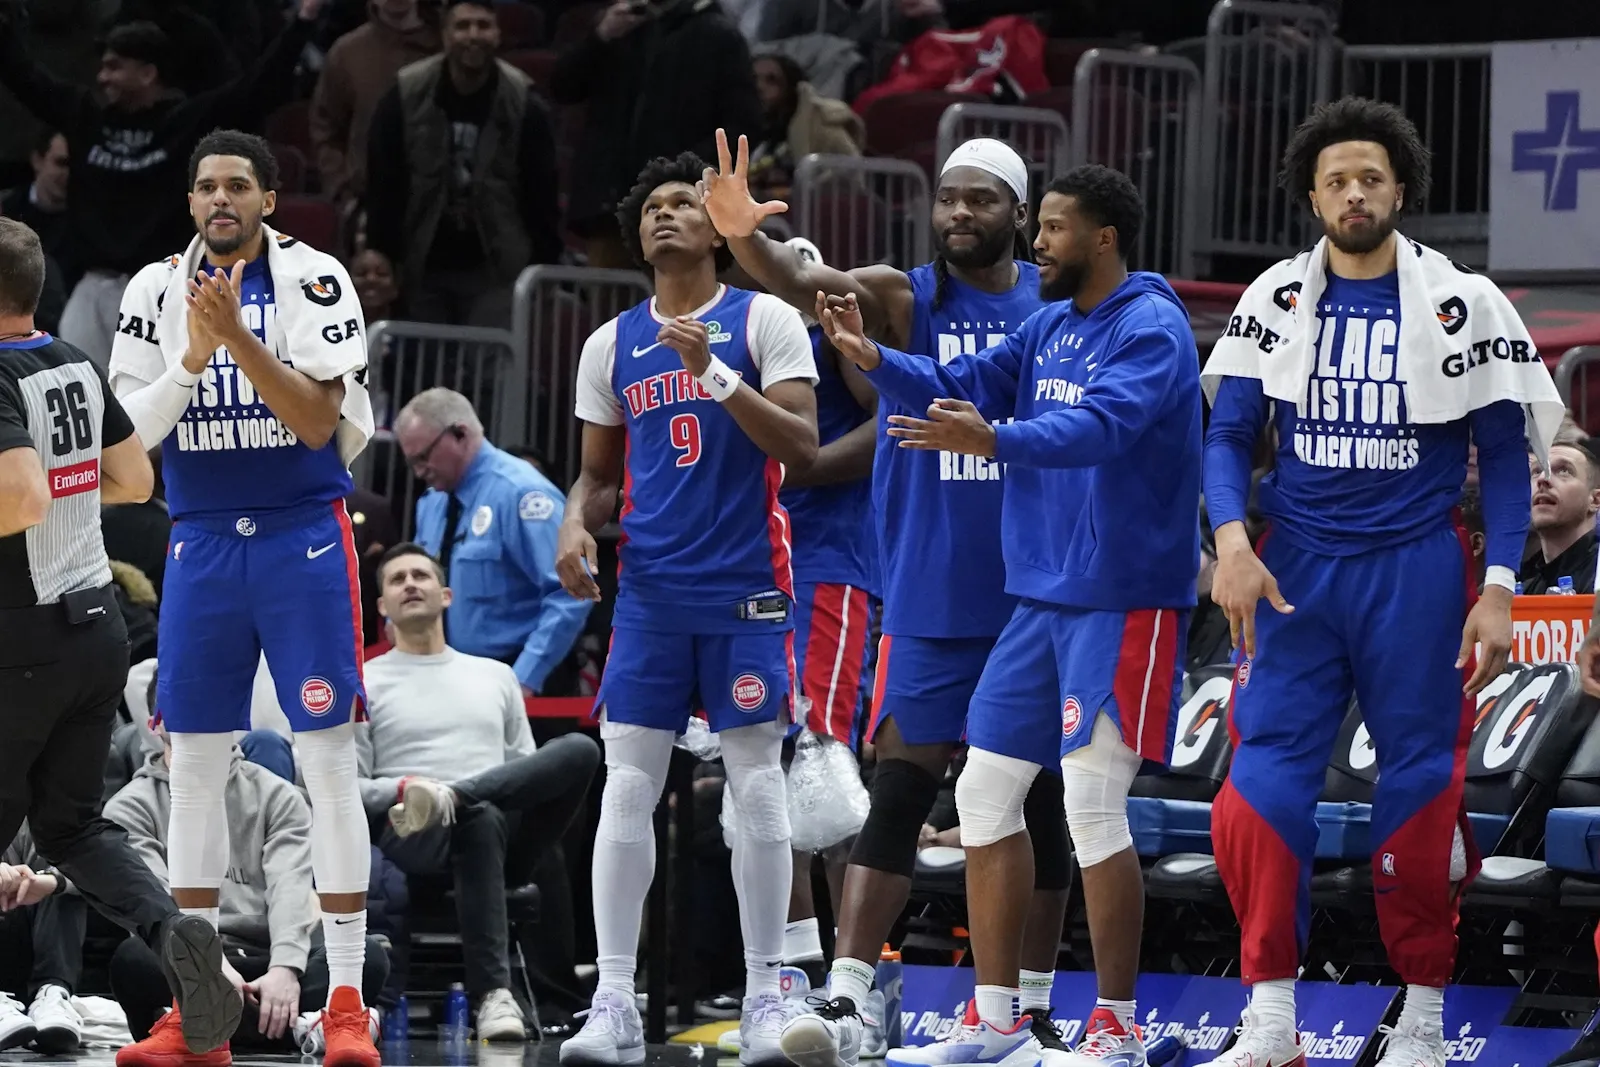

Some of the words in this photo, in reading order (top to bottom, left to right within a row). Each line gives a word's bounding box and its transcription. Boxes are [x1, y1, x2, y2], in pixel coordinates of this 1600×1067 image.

[1324, 304, 1370, 314] UILT
[950, 321, 1006, 329] BUILT
[45, 381, 93, 456] 36
[187, 409, 261, 418] LEVATED
[177, 420, 236, 451] BLACK
[236, 418, 297, 449] VOICES
[669, 413, 702, 467] 9
[1296, 423, 1382, 436] ELEVATED
[1398, 428, 1416, 436] BY
[1294, 433, 1353, 469] BLACK
[1355, 436, 1419, 471] VOICES
[54, 469, 96, 491] Emirates
[1508, 619, 1592, 667] TORA
[912, 1011, 955, 1037] Plus
[1300, 1031, 1365, 1059] Plus500
